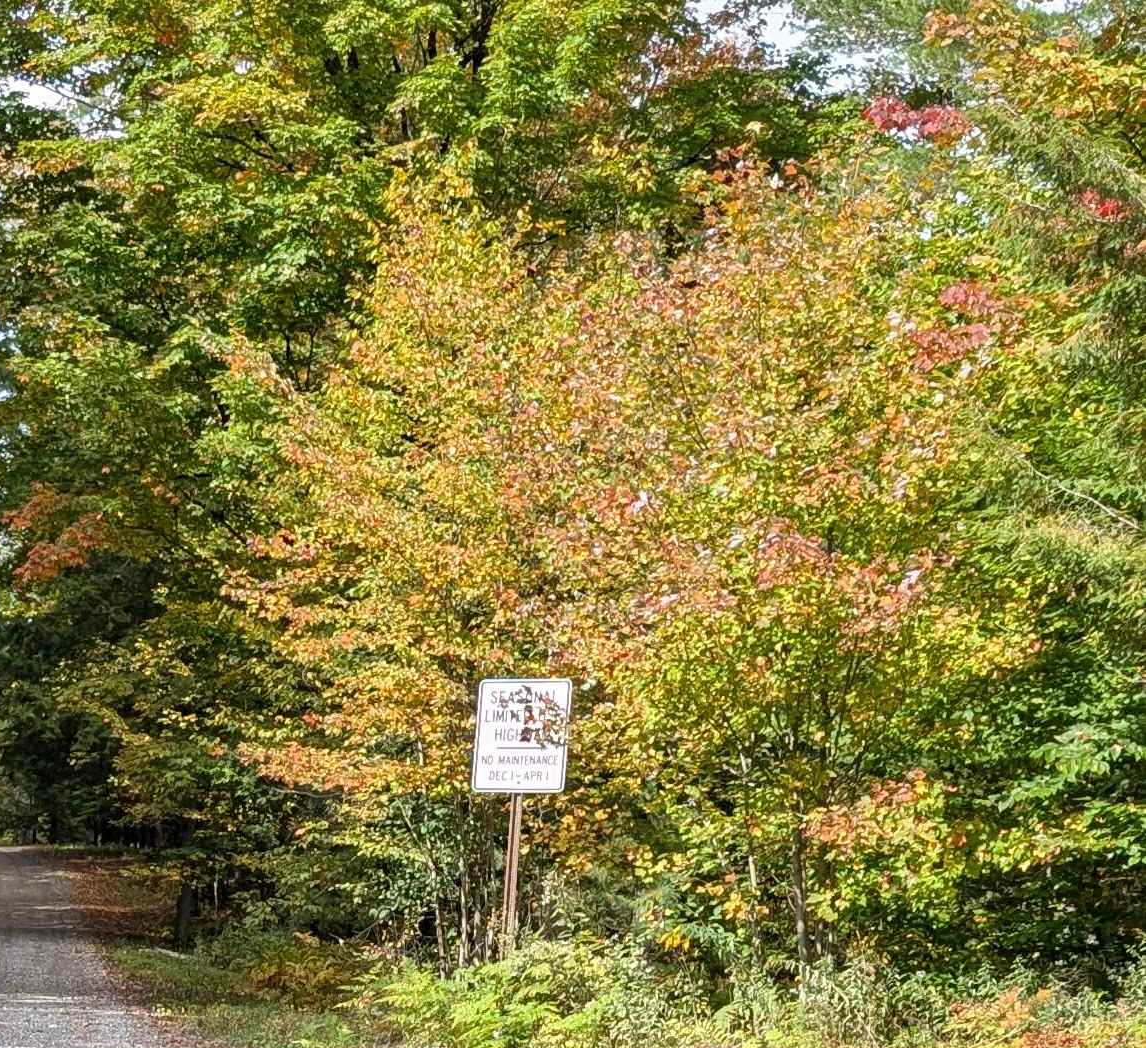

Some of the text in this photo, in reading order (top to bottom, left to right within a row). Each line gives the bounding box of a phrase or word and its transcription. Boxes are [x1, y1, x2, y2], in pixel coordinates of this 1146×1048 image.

[485, 708, 531, 723] LIMITE
[494, 727, 548, 742] HIGHA
[481, 754, 559, 766] NO MAINTENANCE
[488, 770, 508, 781] DEC
